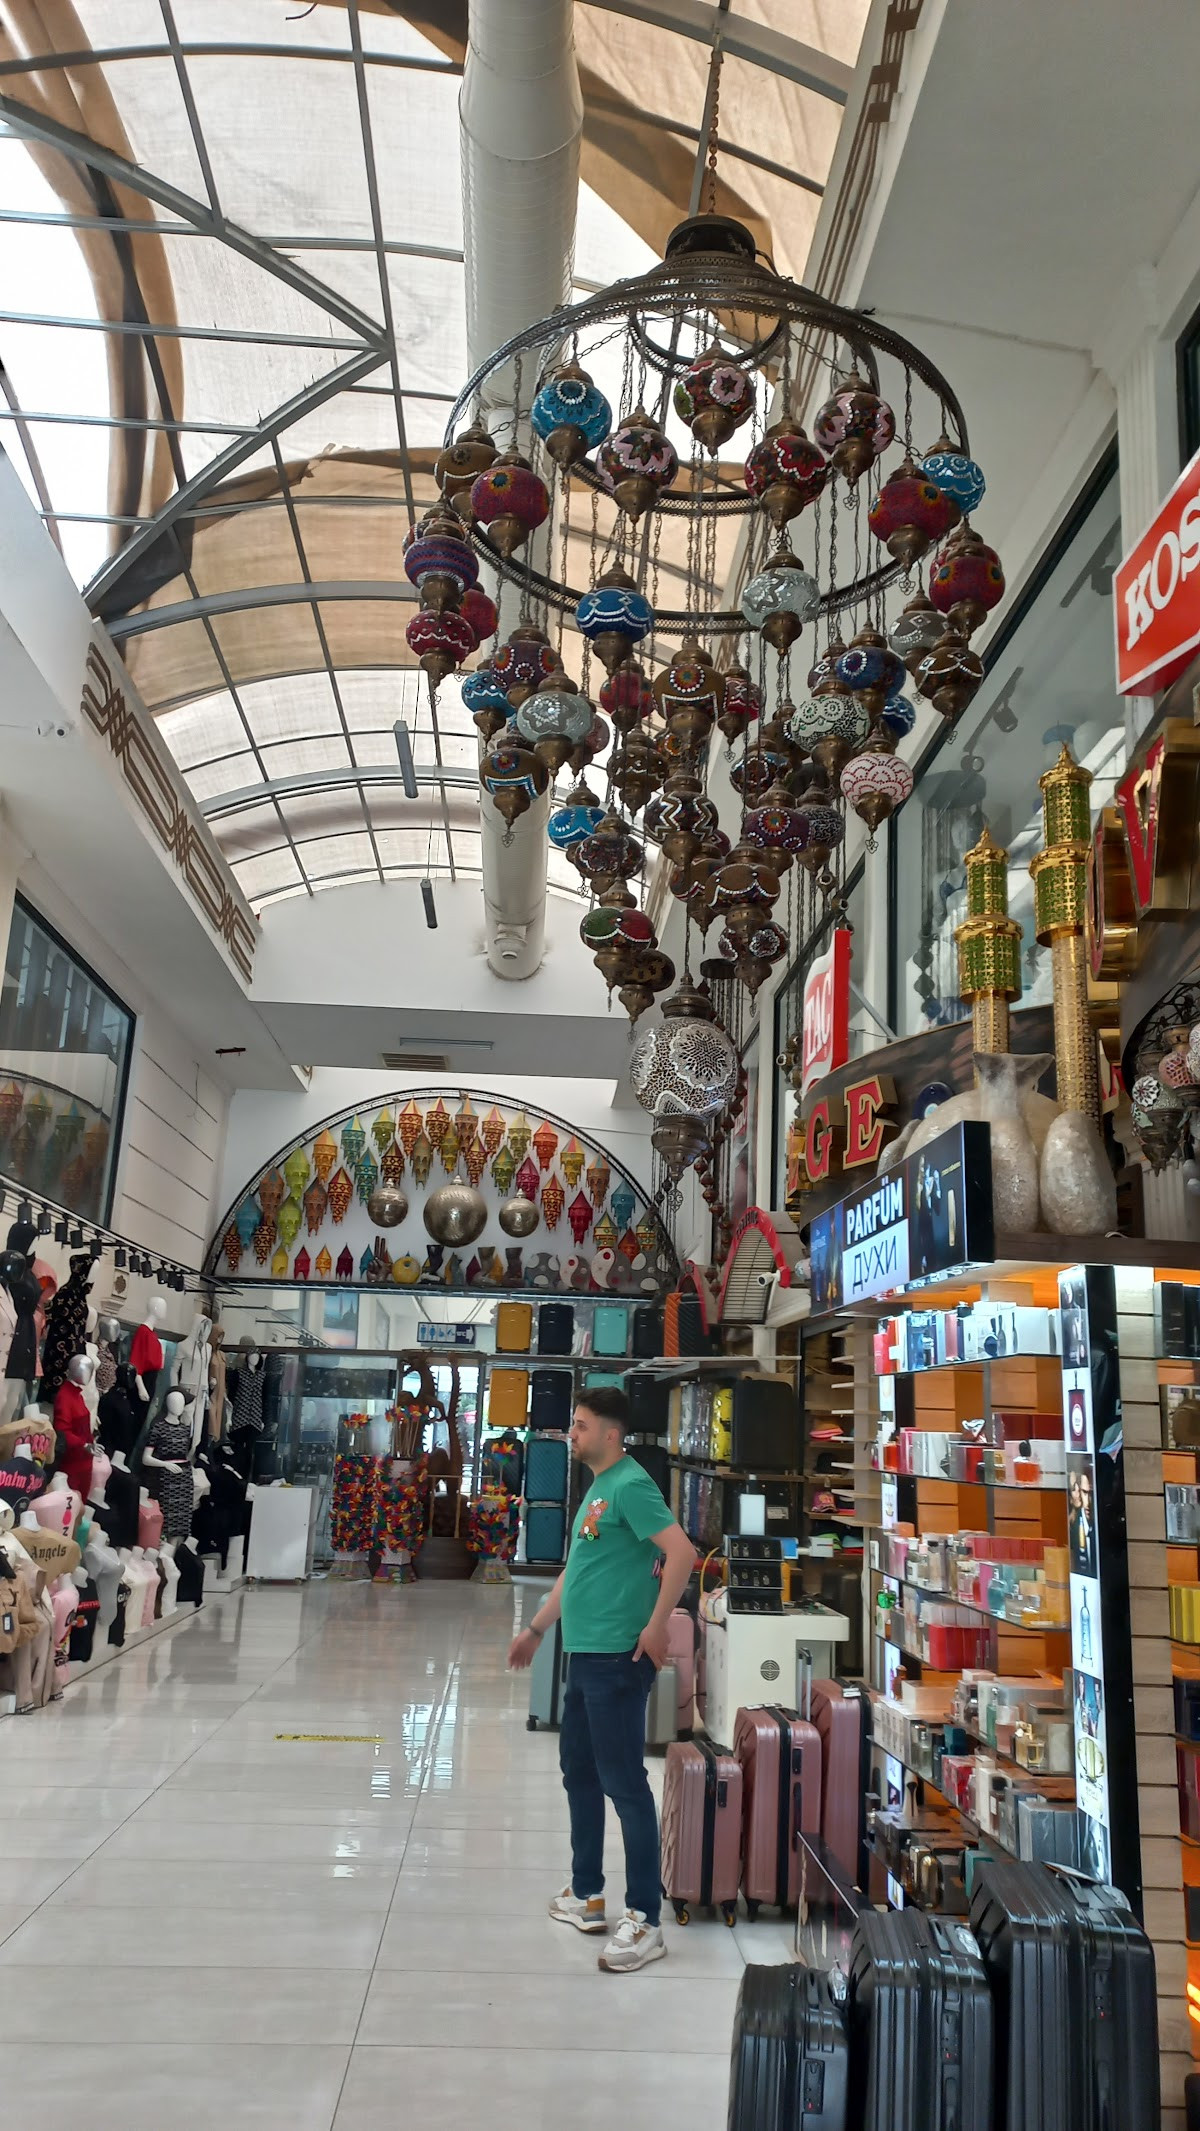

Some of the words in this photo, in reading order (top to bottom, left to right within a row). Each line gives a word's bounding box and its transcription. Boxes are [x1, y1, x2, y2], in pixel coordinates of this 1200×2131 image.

[846, 1175, 904, 1245] PARFÜM
[852, 1235, 898, 1295] ДУХИ
[31, 1544, 67, 1562] Angels
